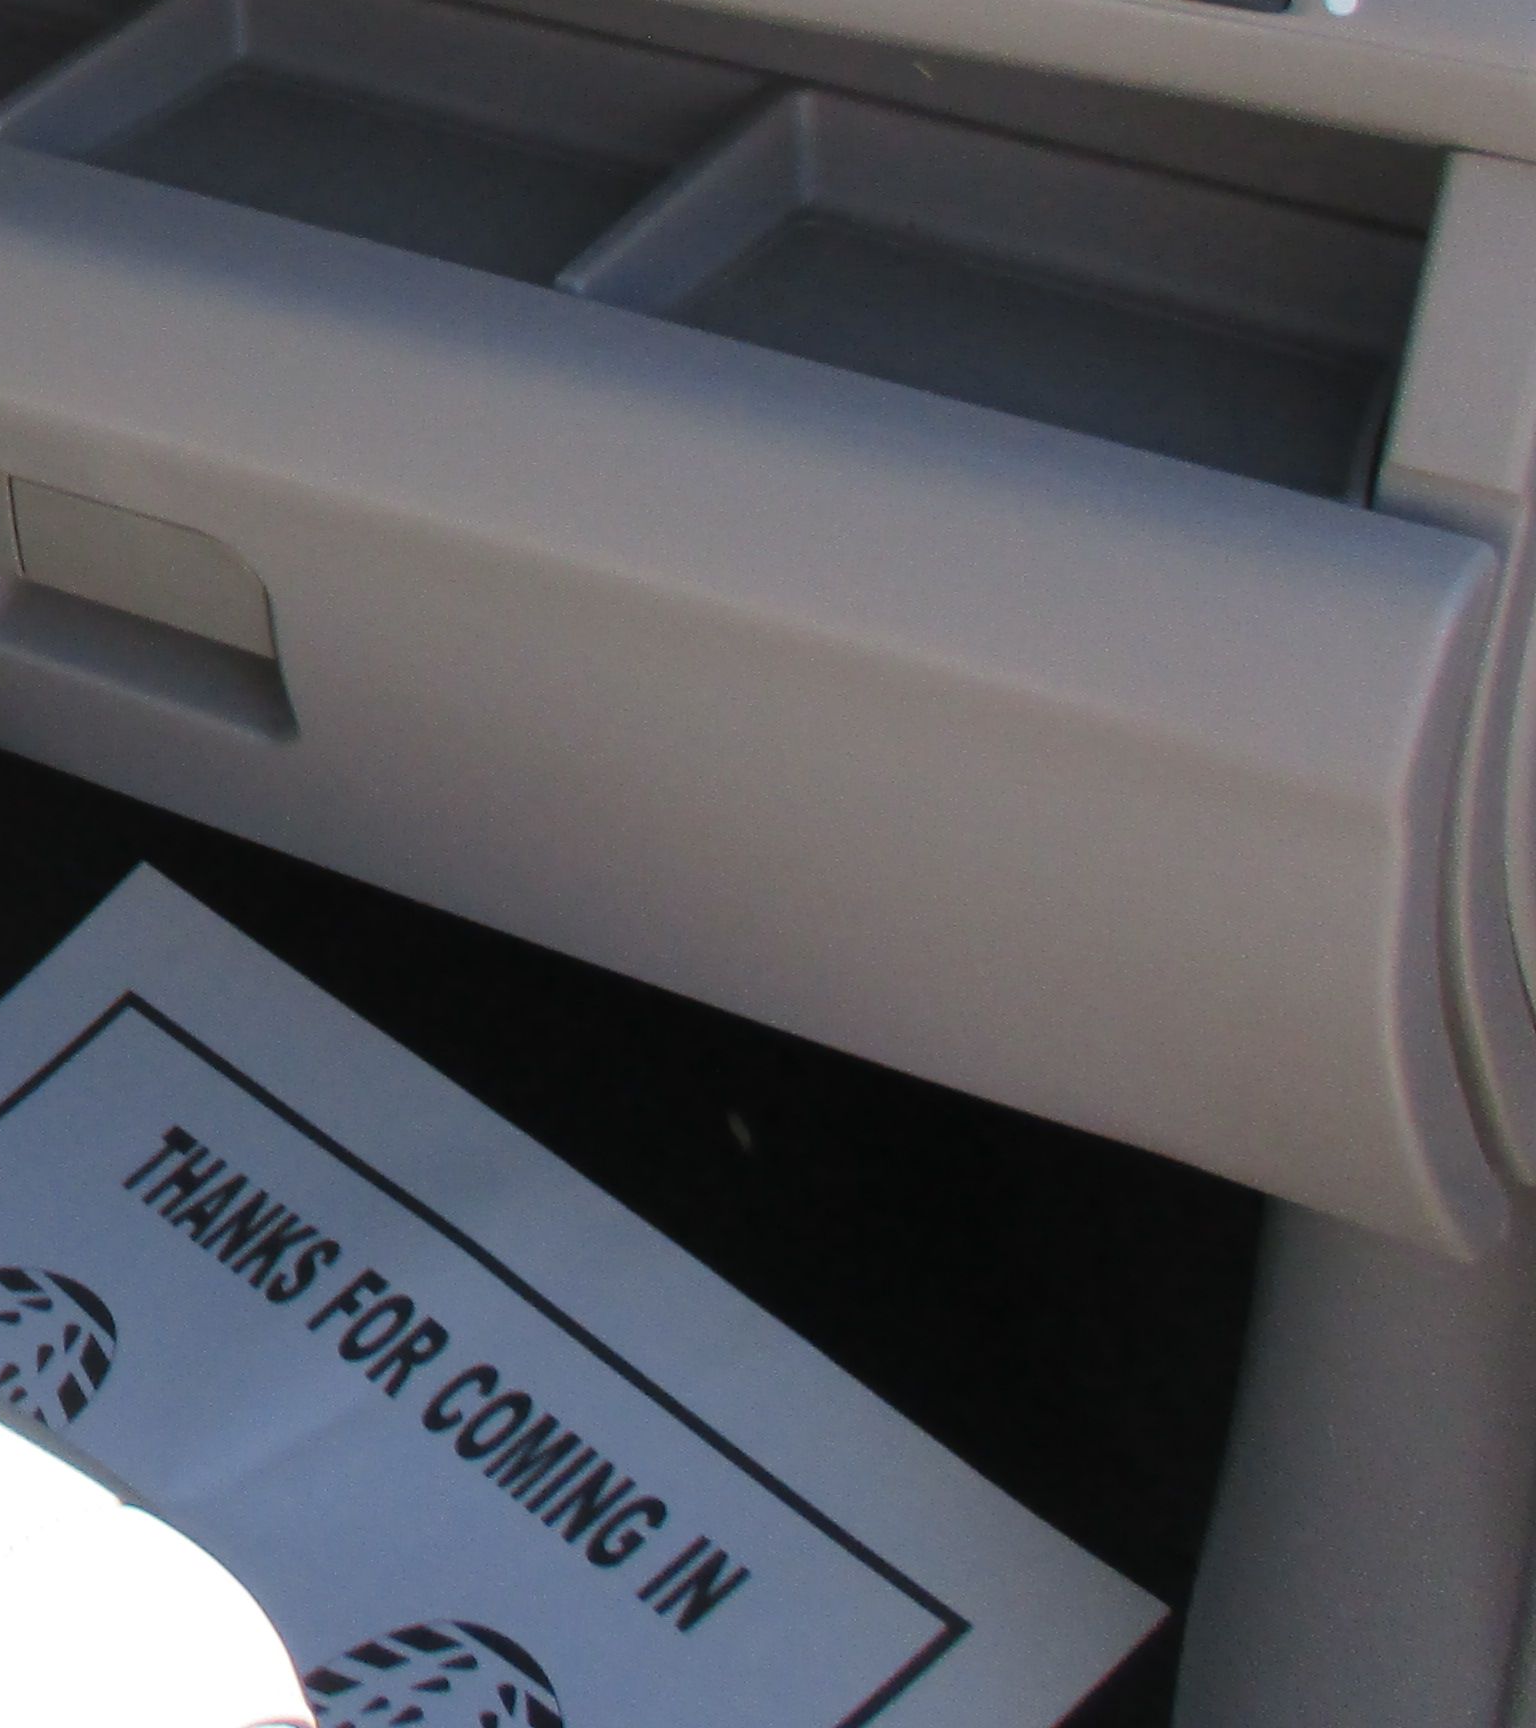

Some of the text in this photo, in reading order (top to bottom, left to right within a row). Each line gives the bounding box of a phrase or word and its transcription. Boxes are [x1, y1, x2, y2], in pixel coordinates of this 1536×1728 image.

[122, 1125, 750, 1632] THANKS FOR COMING IN
